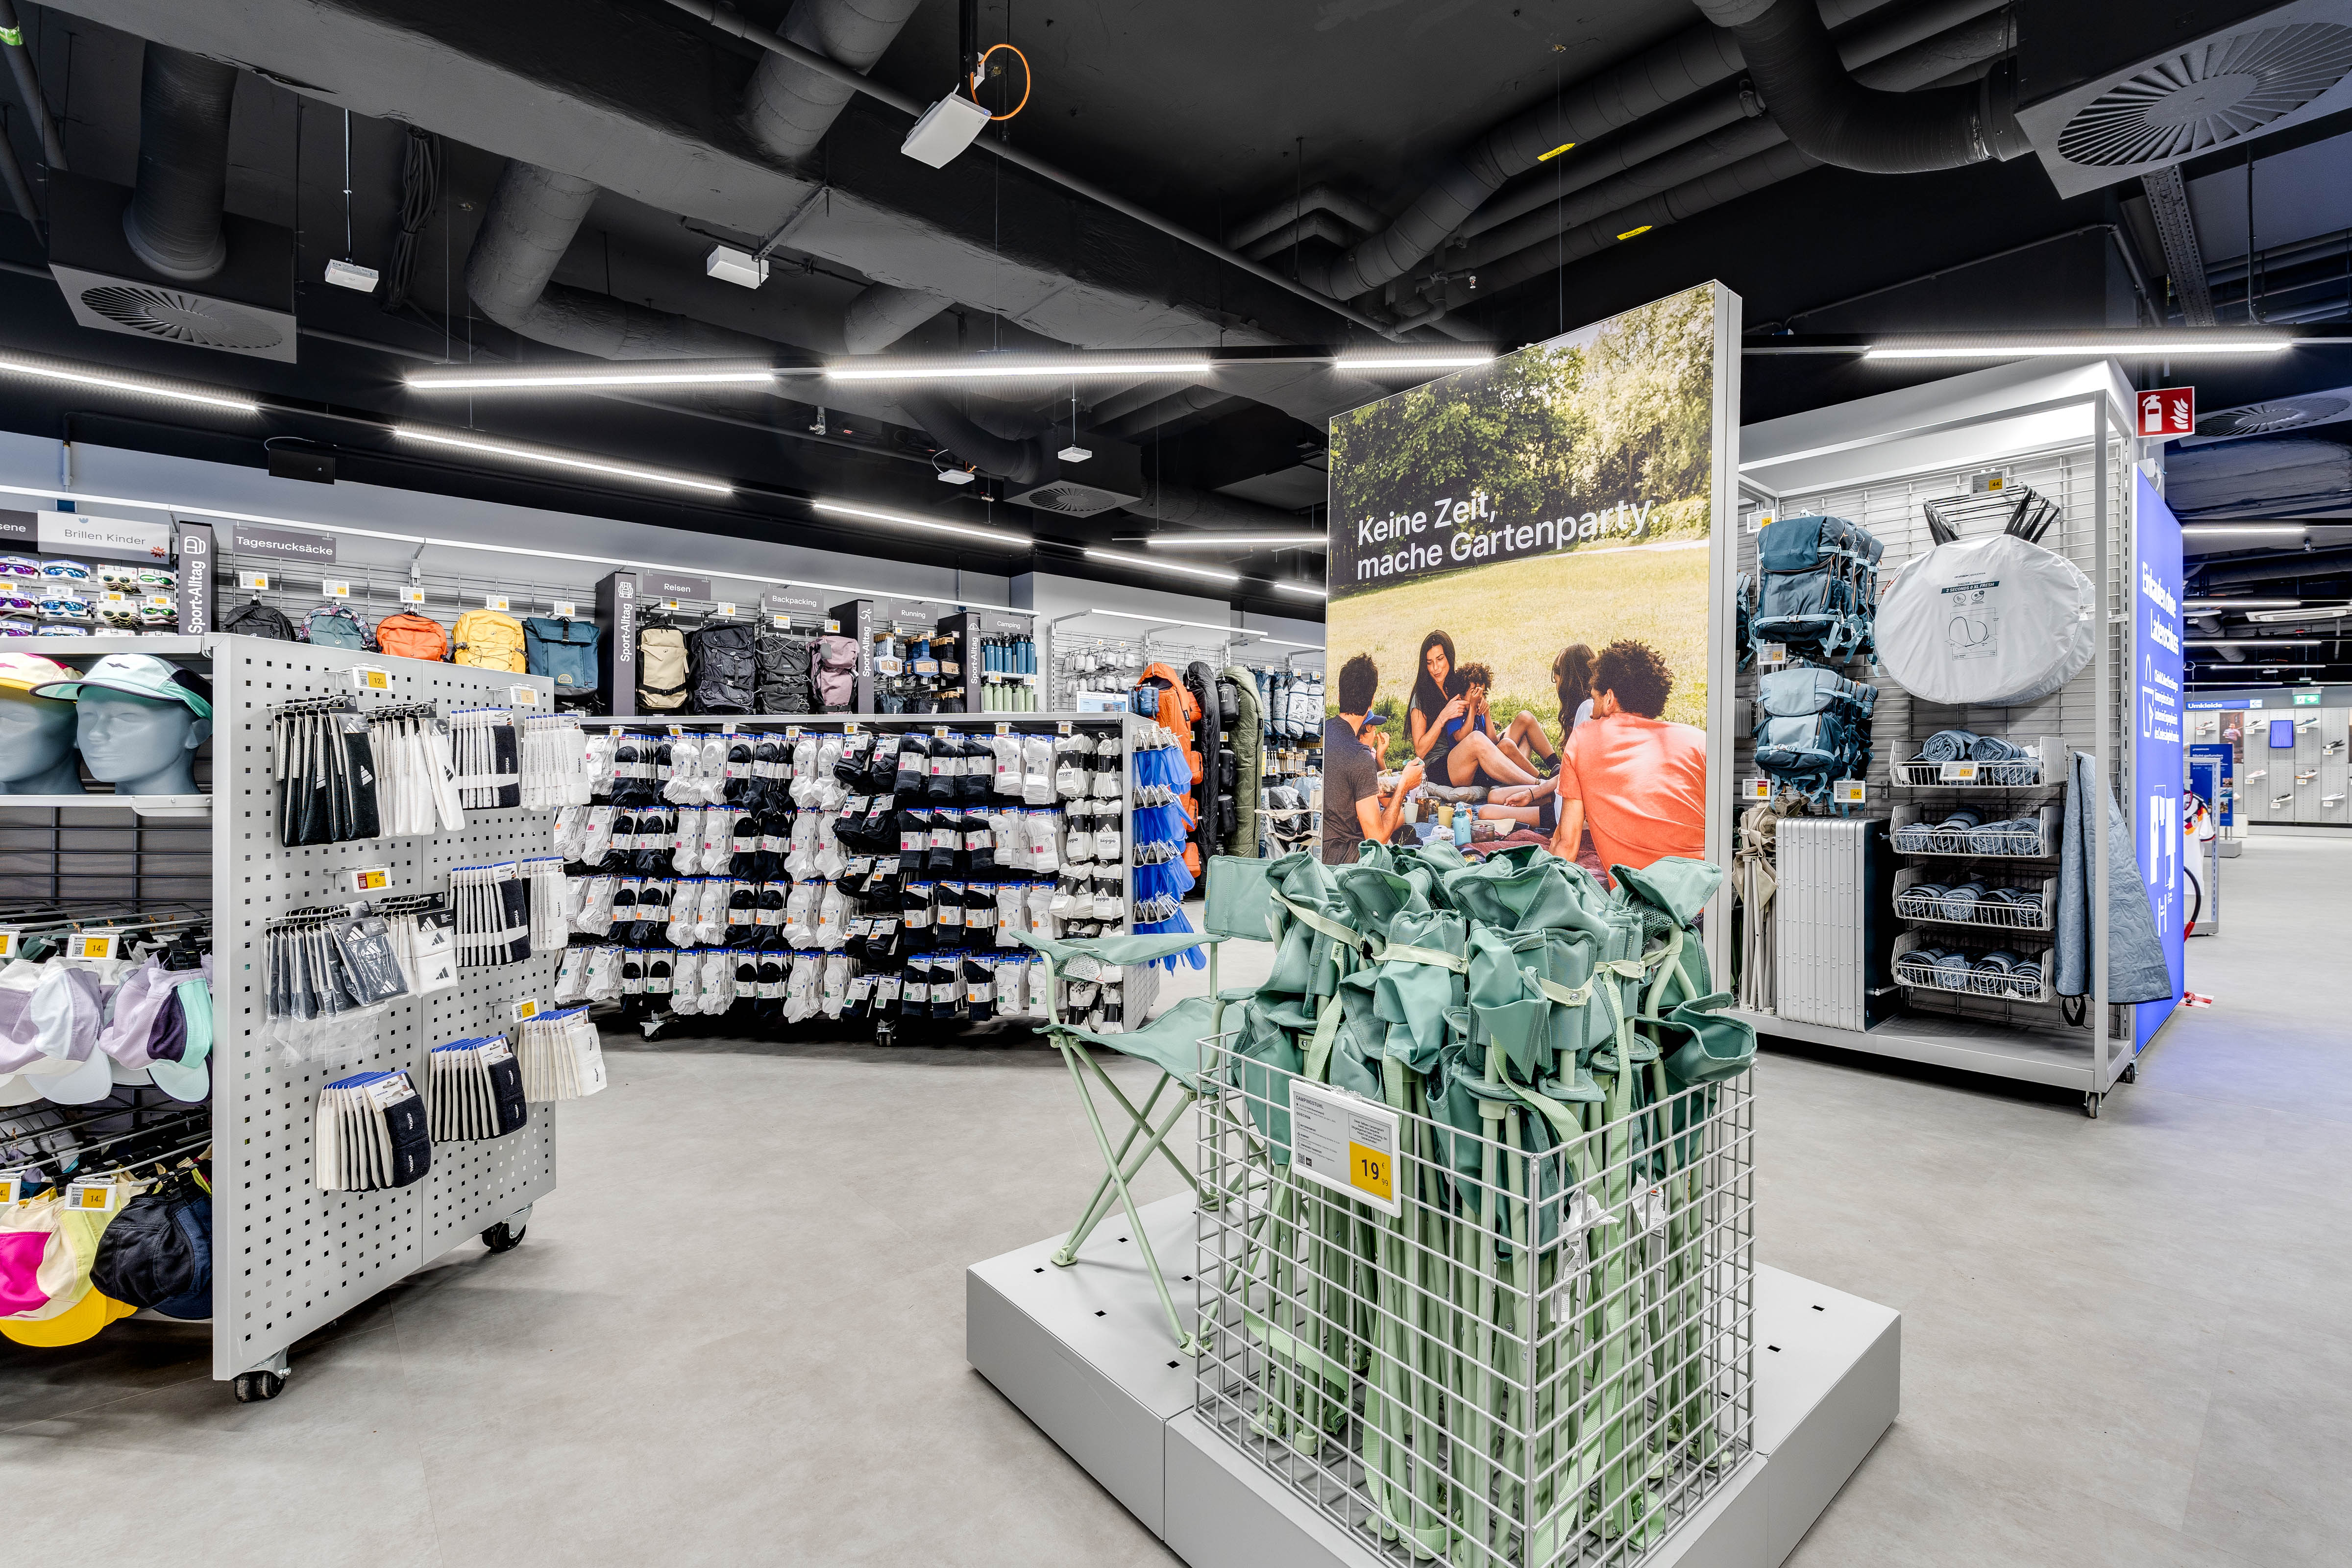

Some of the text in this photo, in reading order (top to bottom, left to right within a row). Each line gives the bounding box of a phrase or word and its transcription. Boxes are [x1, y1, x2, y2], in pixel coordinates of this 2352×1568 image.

[1546, 148, 1560, 157] Abluft
[1358, 491, 1496, 545] Keine Zeit,
[65, 529, 146, 545] Brillen Kinder
[1357, 498, 1660, 580] mache Gartenparty.
[236, 536, 333, 555] Tagesrucksäcke
[664, 583, 691, 593] Reisen
[188, 561, 206, 634] Sport-Alltag
[772, 595, 817, 608] Backpacking
[901, 610, 926, 619] Running
[620, 603, 633, 662] Sport-Alltag
[997, 621, 1021, 630] Camping
[862, 626, 871, 677] Sport-Alltag
[1296, 1095, 1324, 1109] CAMPINGSTUHL
[1296, 1111, 1311, 1120] QUECHUA
[1361, 1159, 1379, 1179] 19
[1382, 1178, 1388, 1187] 99
